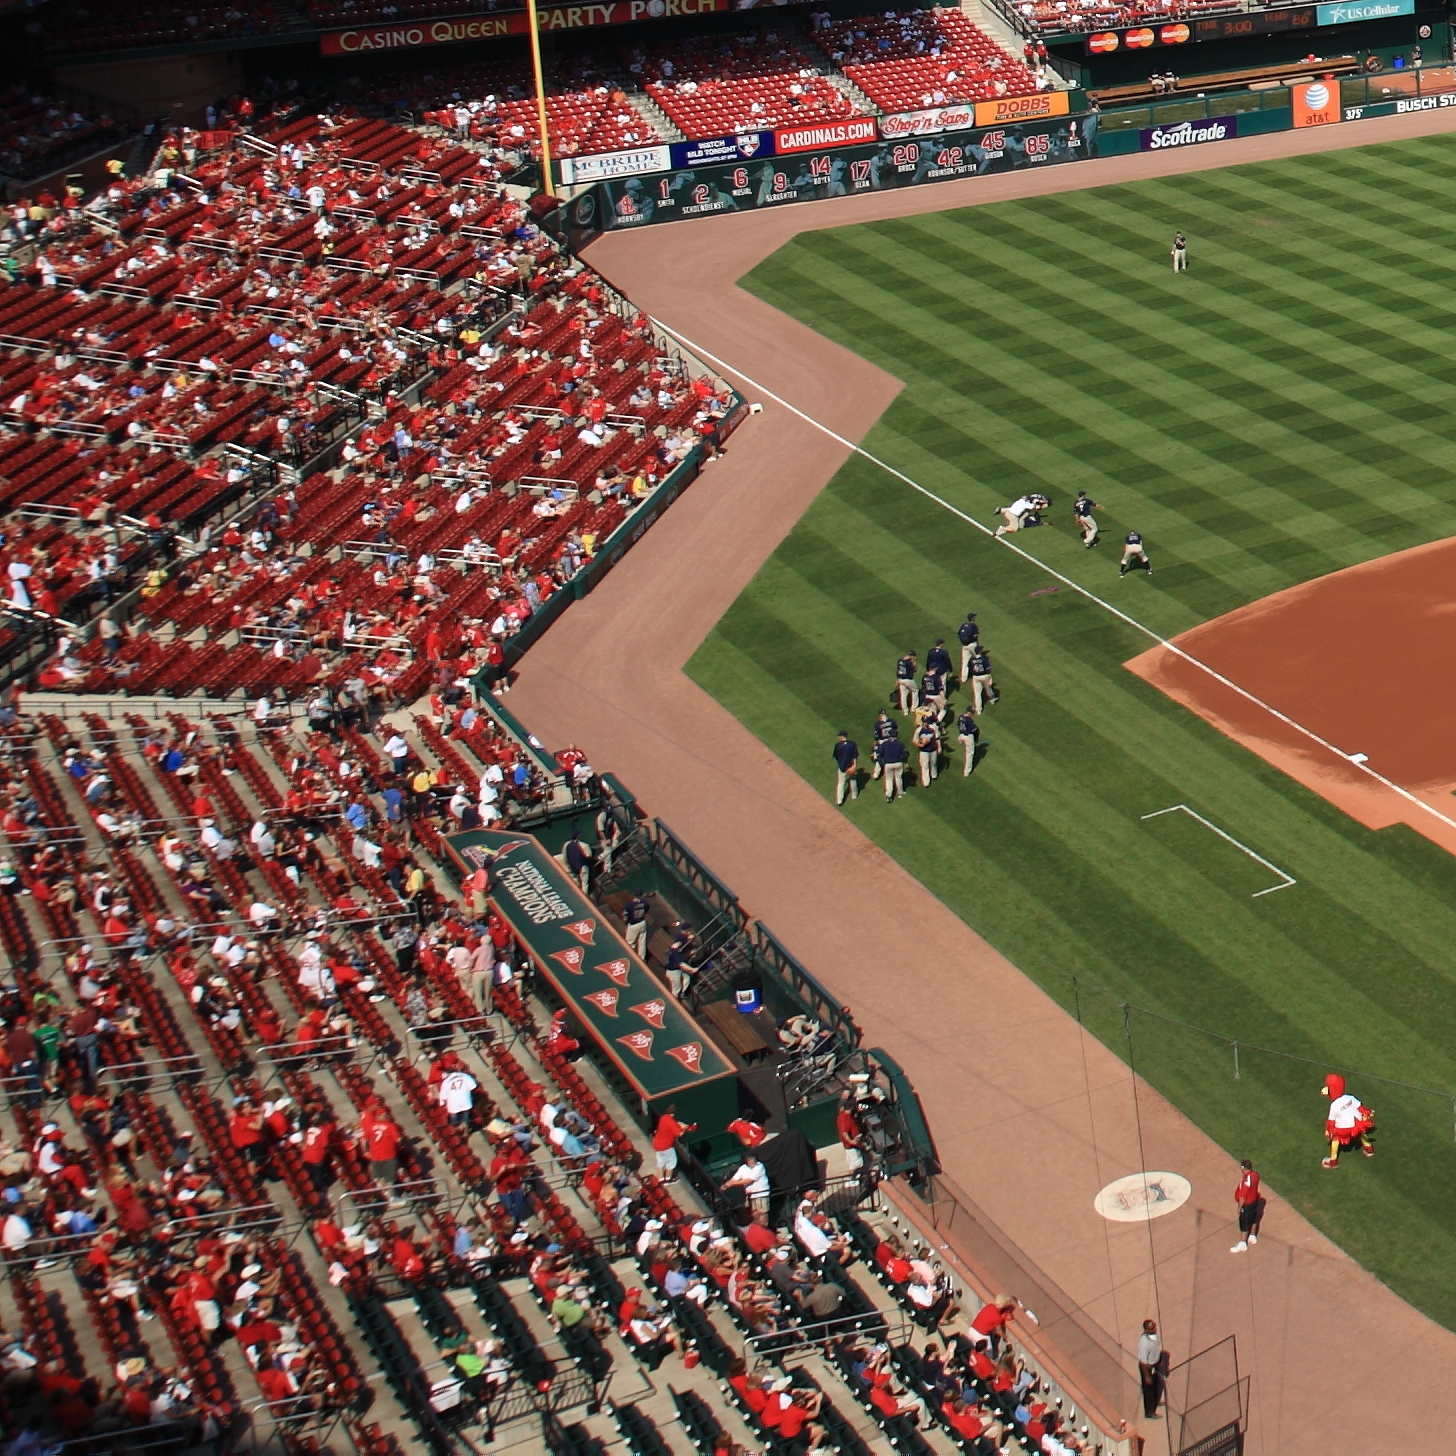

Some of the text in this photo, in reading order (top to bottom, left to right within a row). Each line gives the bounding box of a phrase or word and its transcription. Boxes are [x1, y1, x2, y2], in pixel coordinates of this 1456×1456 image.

[1363, 3, 1400, 18] Cellular
[340, 30, 423, 52] CASINO
[431, 19, 508, 43] QUEEN
[537, 3, 617, 31] PARTY
[1223, 20, 1252, 35] 3:00
[996, 97, 1050, 114] DOBBS
[1397, 97, 1438, 113] BUSCH
[882, 111, 970, 135] Shop'n Save
[1306, 112, 1330, 125] at&t
[780, 122, 875, 149] CARDINALS.COM
[980, 131, 1006, 152] 45
[1025, 134, 1050, 156] 85
[1150, 121, 1227, 149] Scottrade
[893, 144, 919, 165] 20
[937, 147, 963, 168] 42
[603, 160, 662, 177] HOMES
[809, 156, 831, 177] 14
[851, 160, 870, 181] 17
[733, 168, 748, 187] 6
[773, 172, 788, 192] 9
[659, 178, 669, 200] 1
[695, 184, 709, 204] 2
[496, 866, 556, 925] CHAMPIONS
[516, 859, 574, 919] NATIONAL LEAGUE
[449, 1079, 463, 1091] 47
